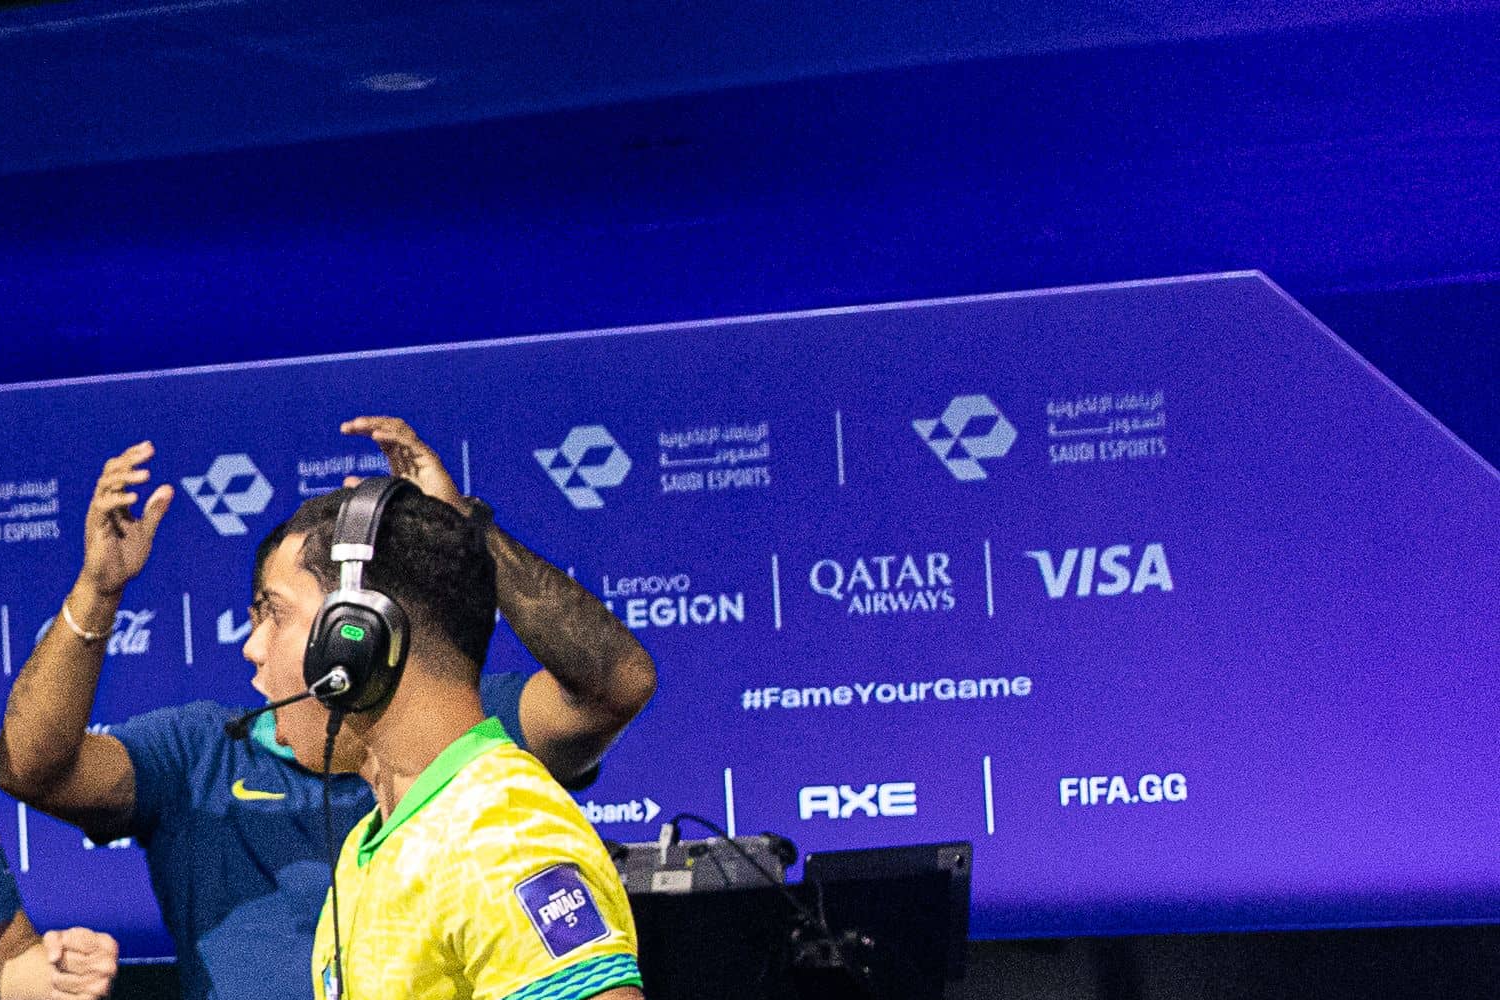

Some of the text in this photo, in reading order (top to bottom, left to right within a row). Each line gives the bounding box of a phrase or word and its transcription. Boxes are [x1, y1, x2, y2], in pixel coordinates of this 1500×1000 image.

[603, 574, 690, 597] Lenovo
[809, 552, 953, 600] QATAR
[1026, 543, 1173, 598] VISA
[606, 592, 745, 629] EGION
[848, 589, 955, 615] AIRWAYS
[742, 676, 1032, 710] #FameYourGame
[799, 782, 917, 819] AXE
[1060, 773, 1188, 806] FIFA.GG
[538, 888, 587, 925] FINALS
